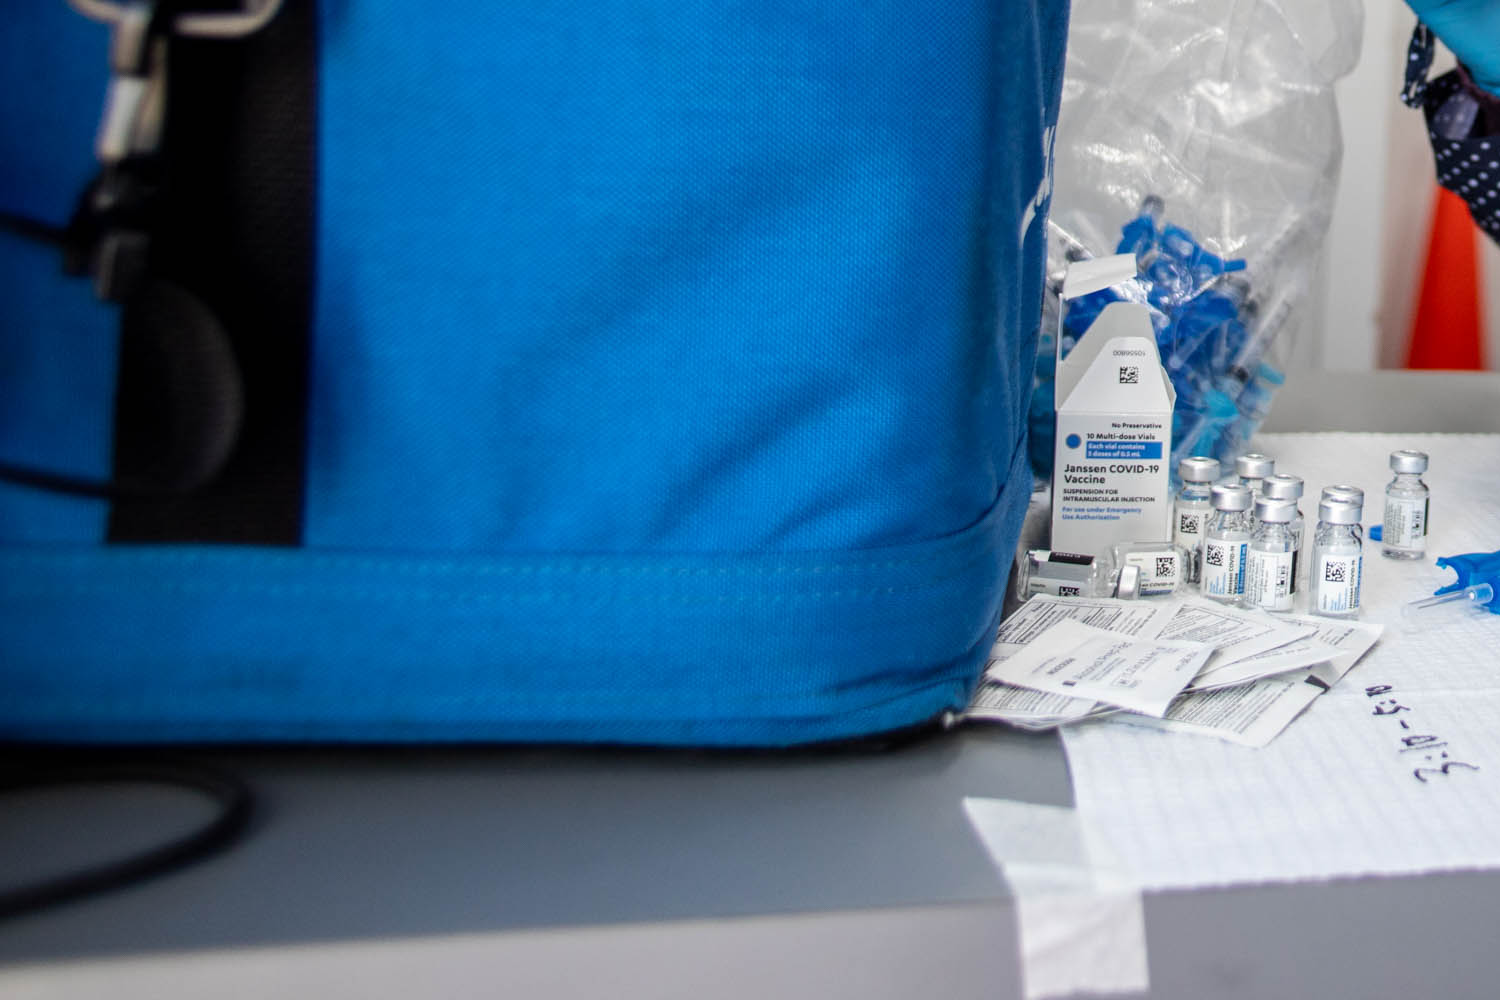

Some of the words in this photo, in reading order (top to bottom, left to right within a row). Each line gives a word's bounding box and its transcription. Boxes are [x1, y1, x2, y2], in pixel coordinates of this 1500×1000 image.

[1064, 464, 1107, 473] Janssen
[1109, 464, 1160, 473] COVID-19
[1064, 475, 1106, 484] Vaccine
